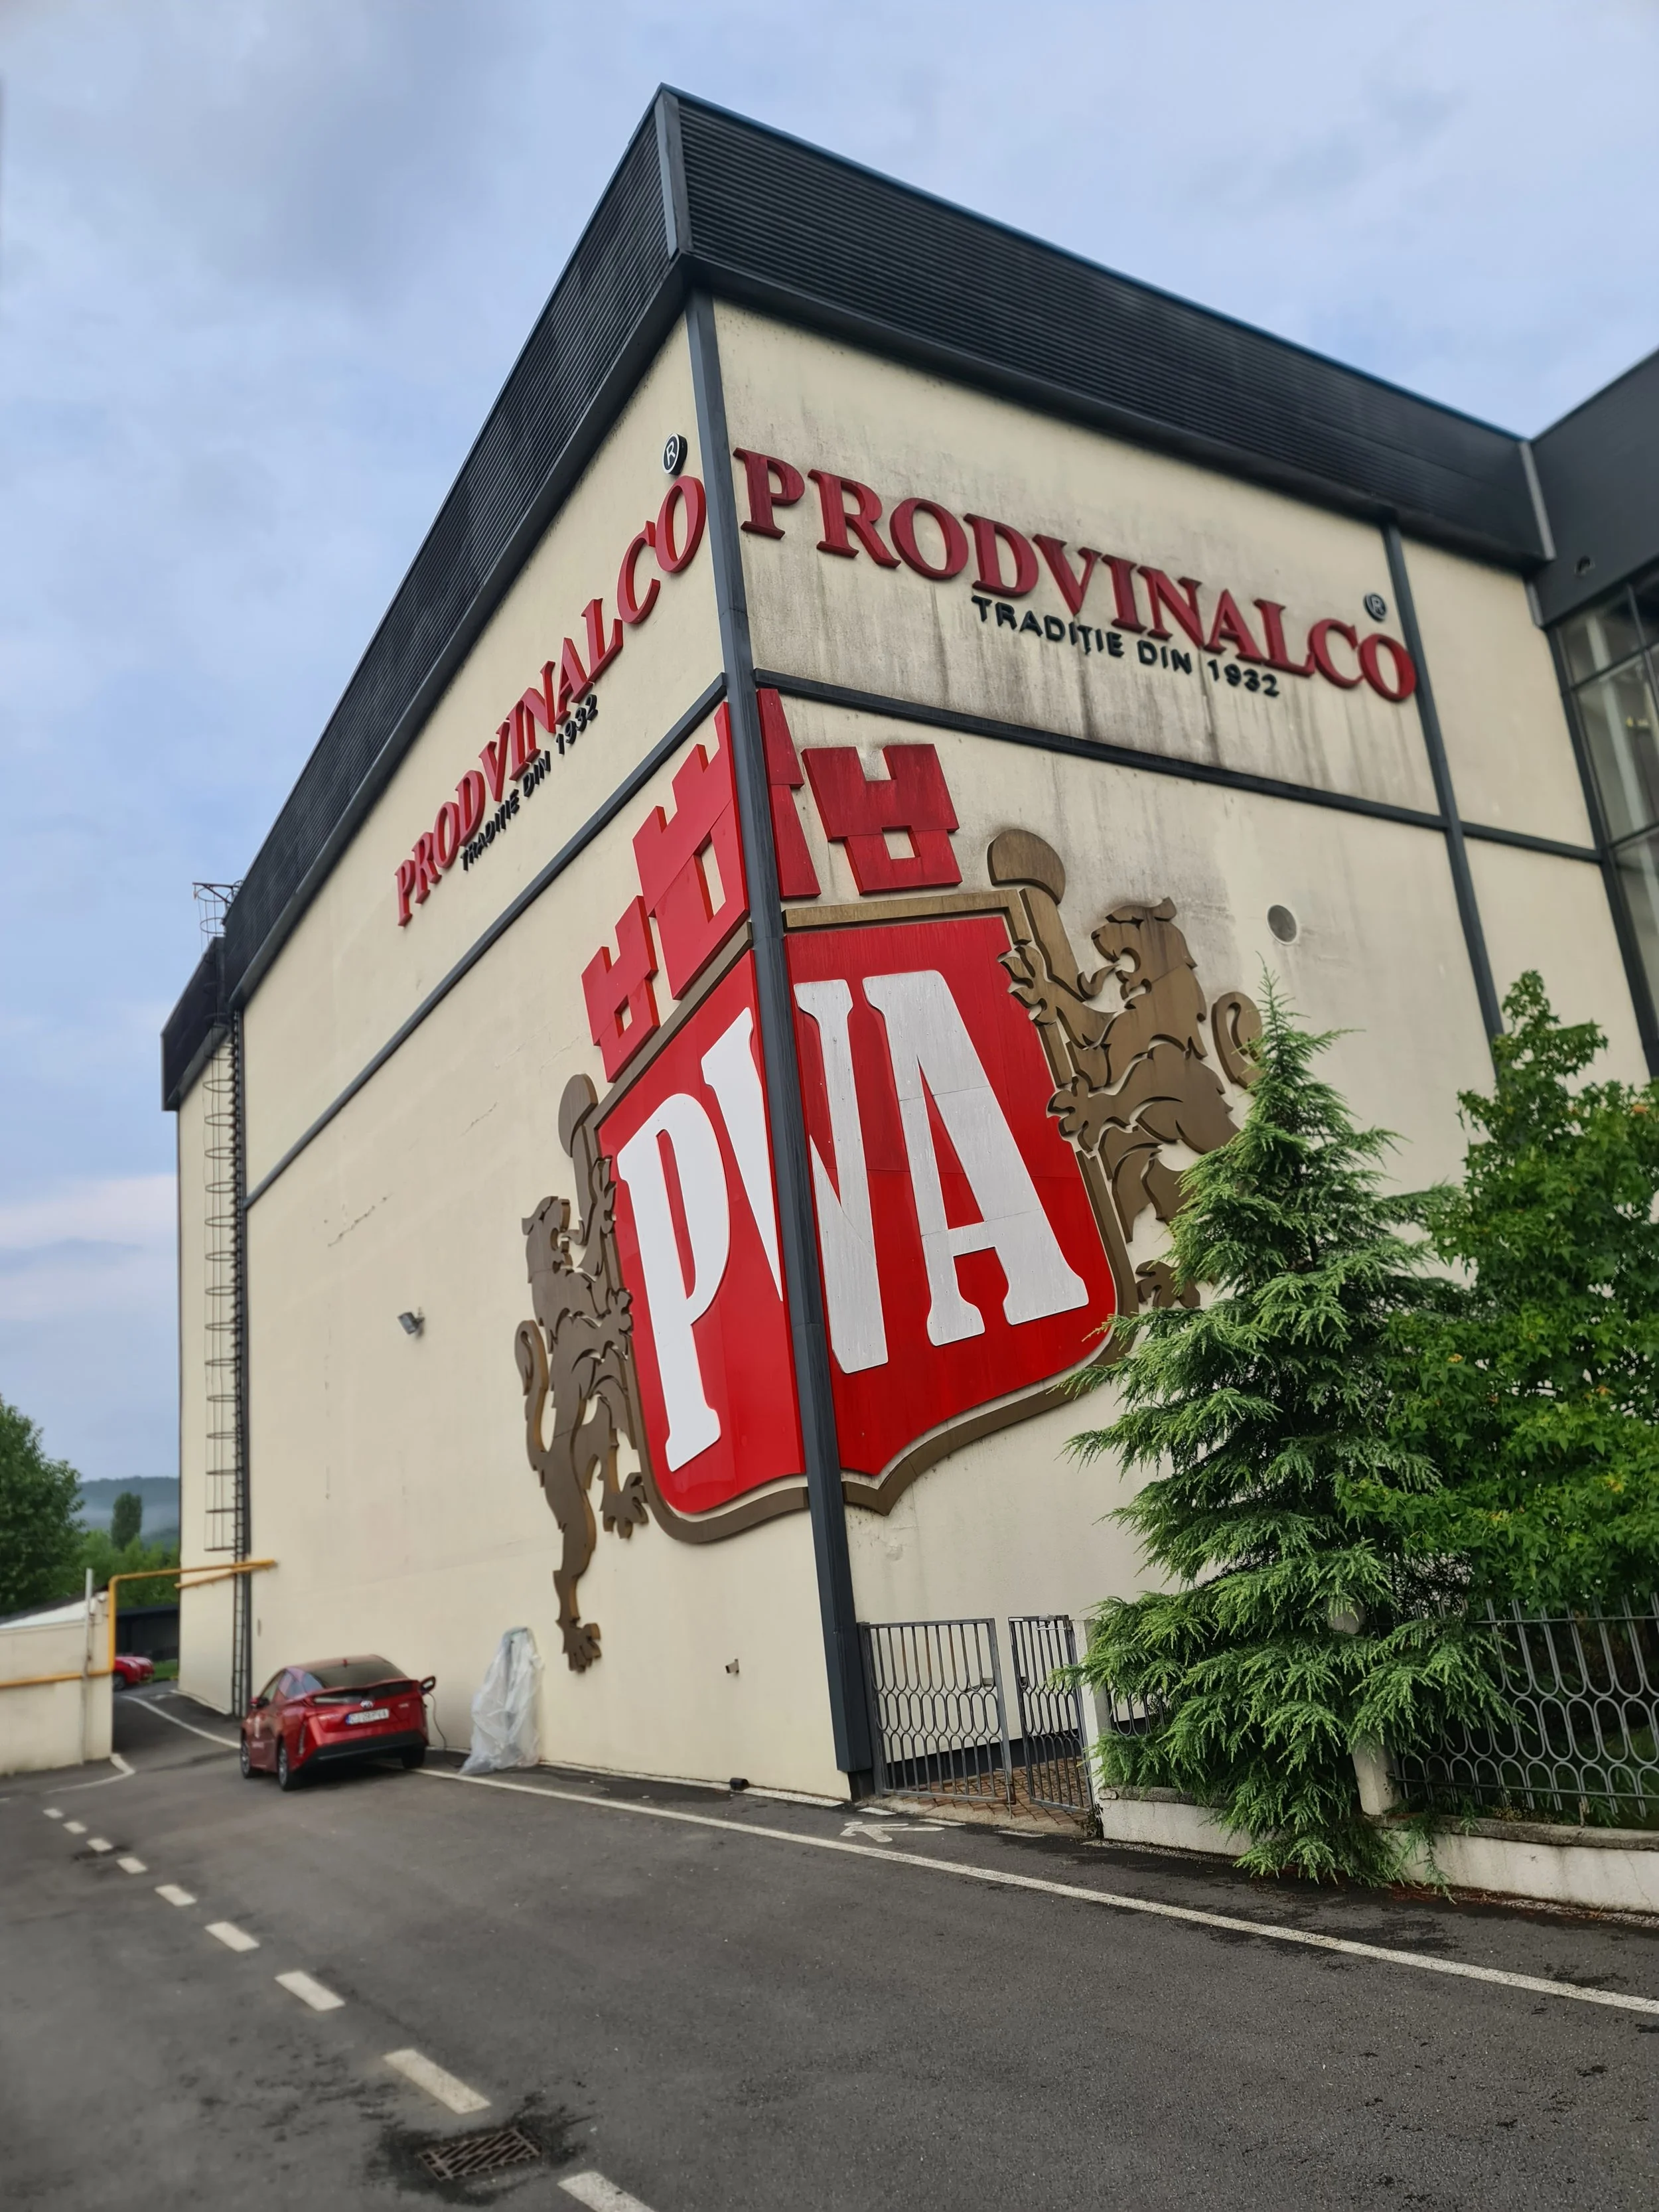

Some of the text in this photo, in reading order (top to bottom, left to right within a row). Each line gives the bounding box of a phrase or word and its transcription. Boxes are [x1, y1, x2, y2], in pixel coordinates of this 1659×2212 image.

[394, 475, 707, 928] PRODVINALCO
[733, 447, 1417, 703] PRODVINALCO
[1137, 639, 1192, 674] DIN
[1207, 660, 1279, 697] 1932
[522, 751, 551, 798] DIN
[555, 694, 598, 755] 1932
[617, 970, 1090, 1472] PVA
